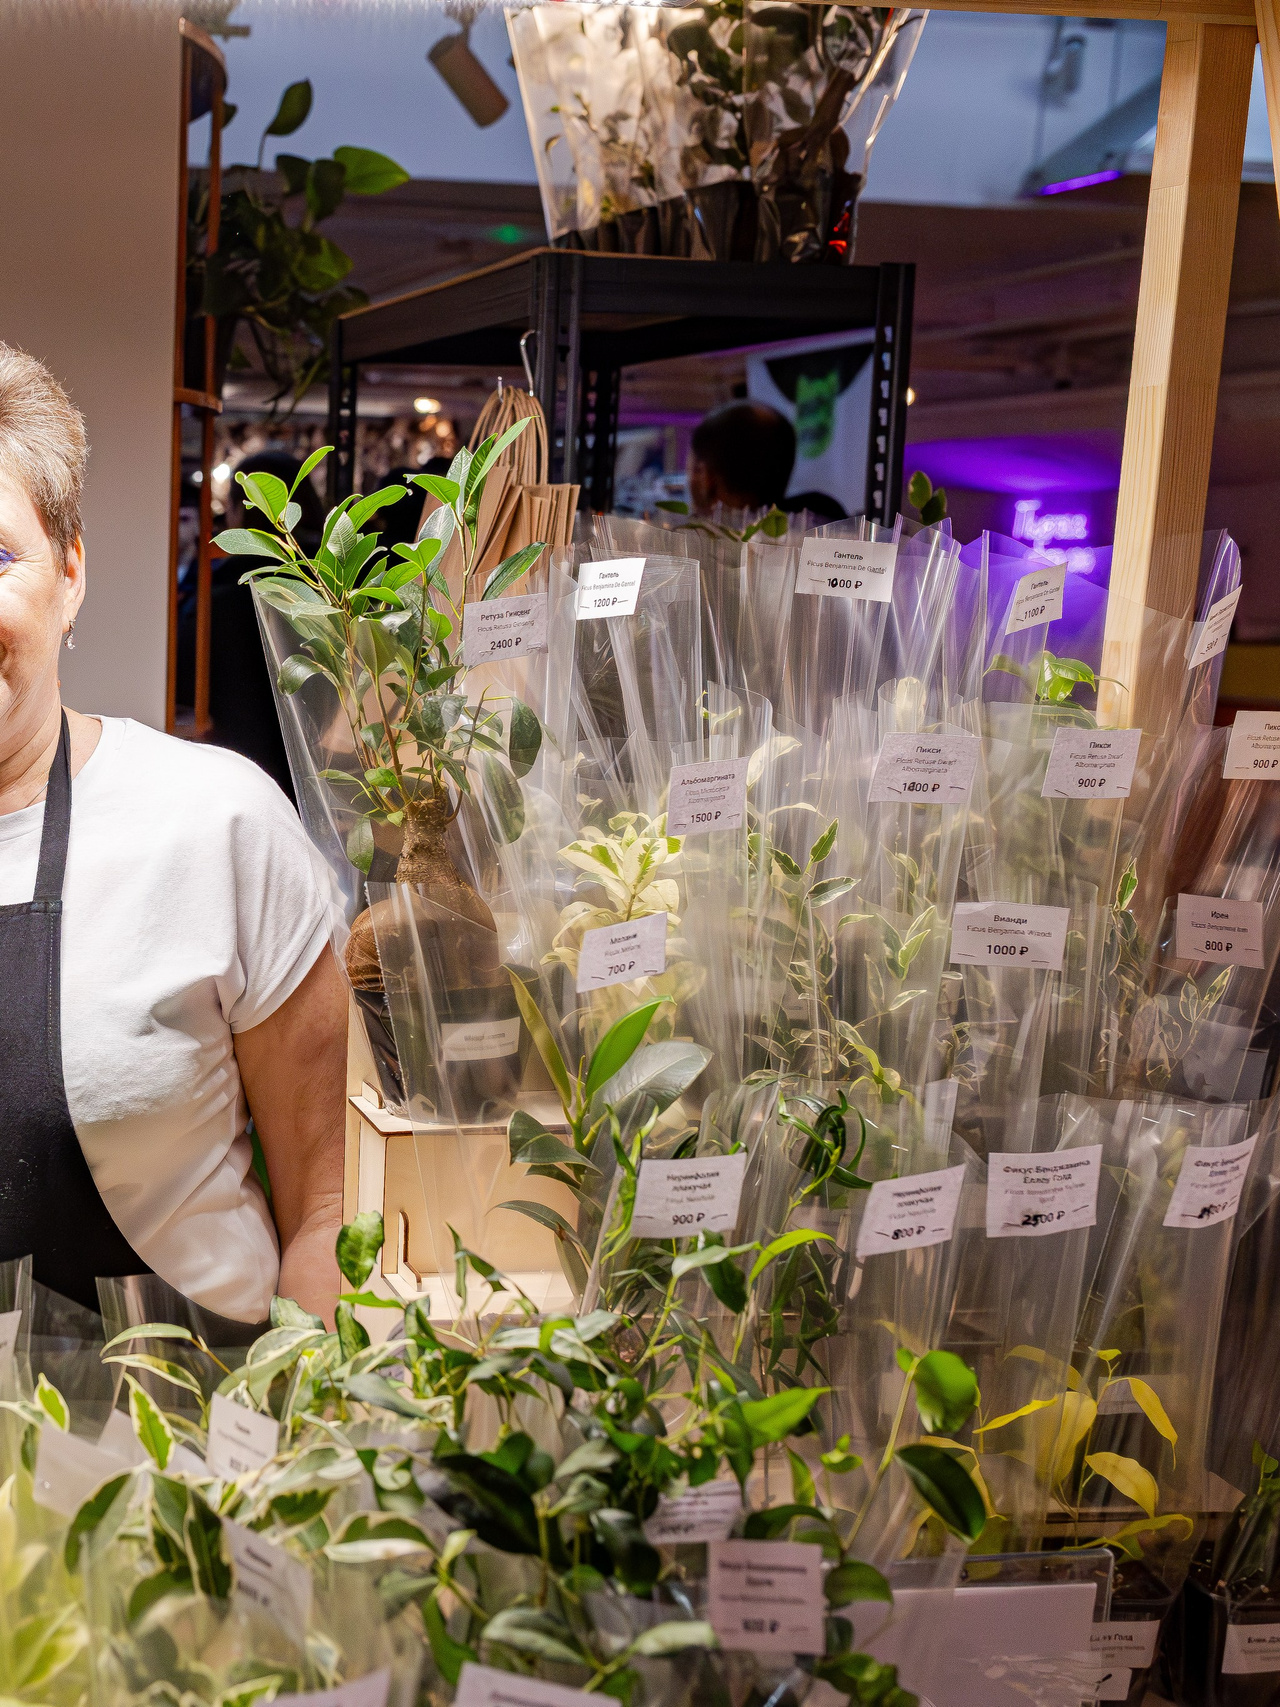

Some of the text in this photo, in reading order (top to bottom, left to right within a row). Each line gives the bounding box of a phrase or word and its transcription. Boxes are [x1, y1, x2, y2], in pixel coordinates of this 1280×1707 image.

[834, 551, 863, 560] Гантель
[594, 598, 610, 607] 1200
[1024, 607, 1039, 619] 1100
[490, 639, 512, 650] 2400
[916, 746, 941, 754] Пикси
[1253, 759, 1269, 768] 900
[681, 774, 735, 785] Альбомаргината
[1078, 778, 1097, 788] 900
[691, 812, 712, 823] 1500
[993, 915, 1028, 925] Вианди
[1211, 911, 1229, 919] Ирен
[986, 944, 1016, 955] 1000
[1205, 940, 1223, 951] 800
[607, 964, 625, 976] 700
[672, 1214, 694, 1225] 900
[891, 1228, 914, 1240] 800
